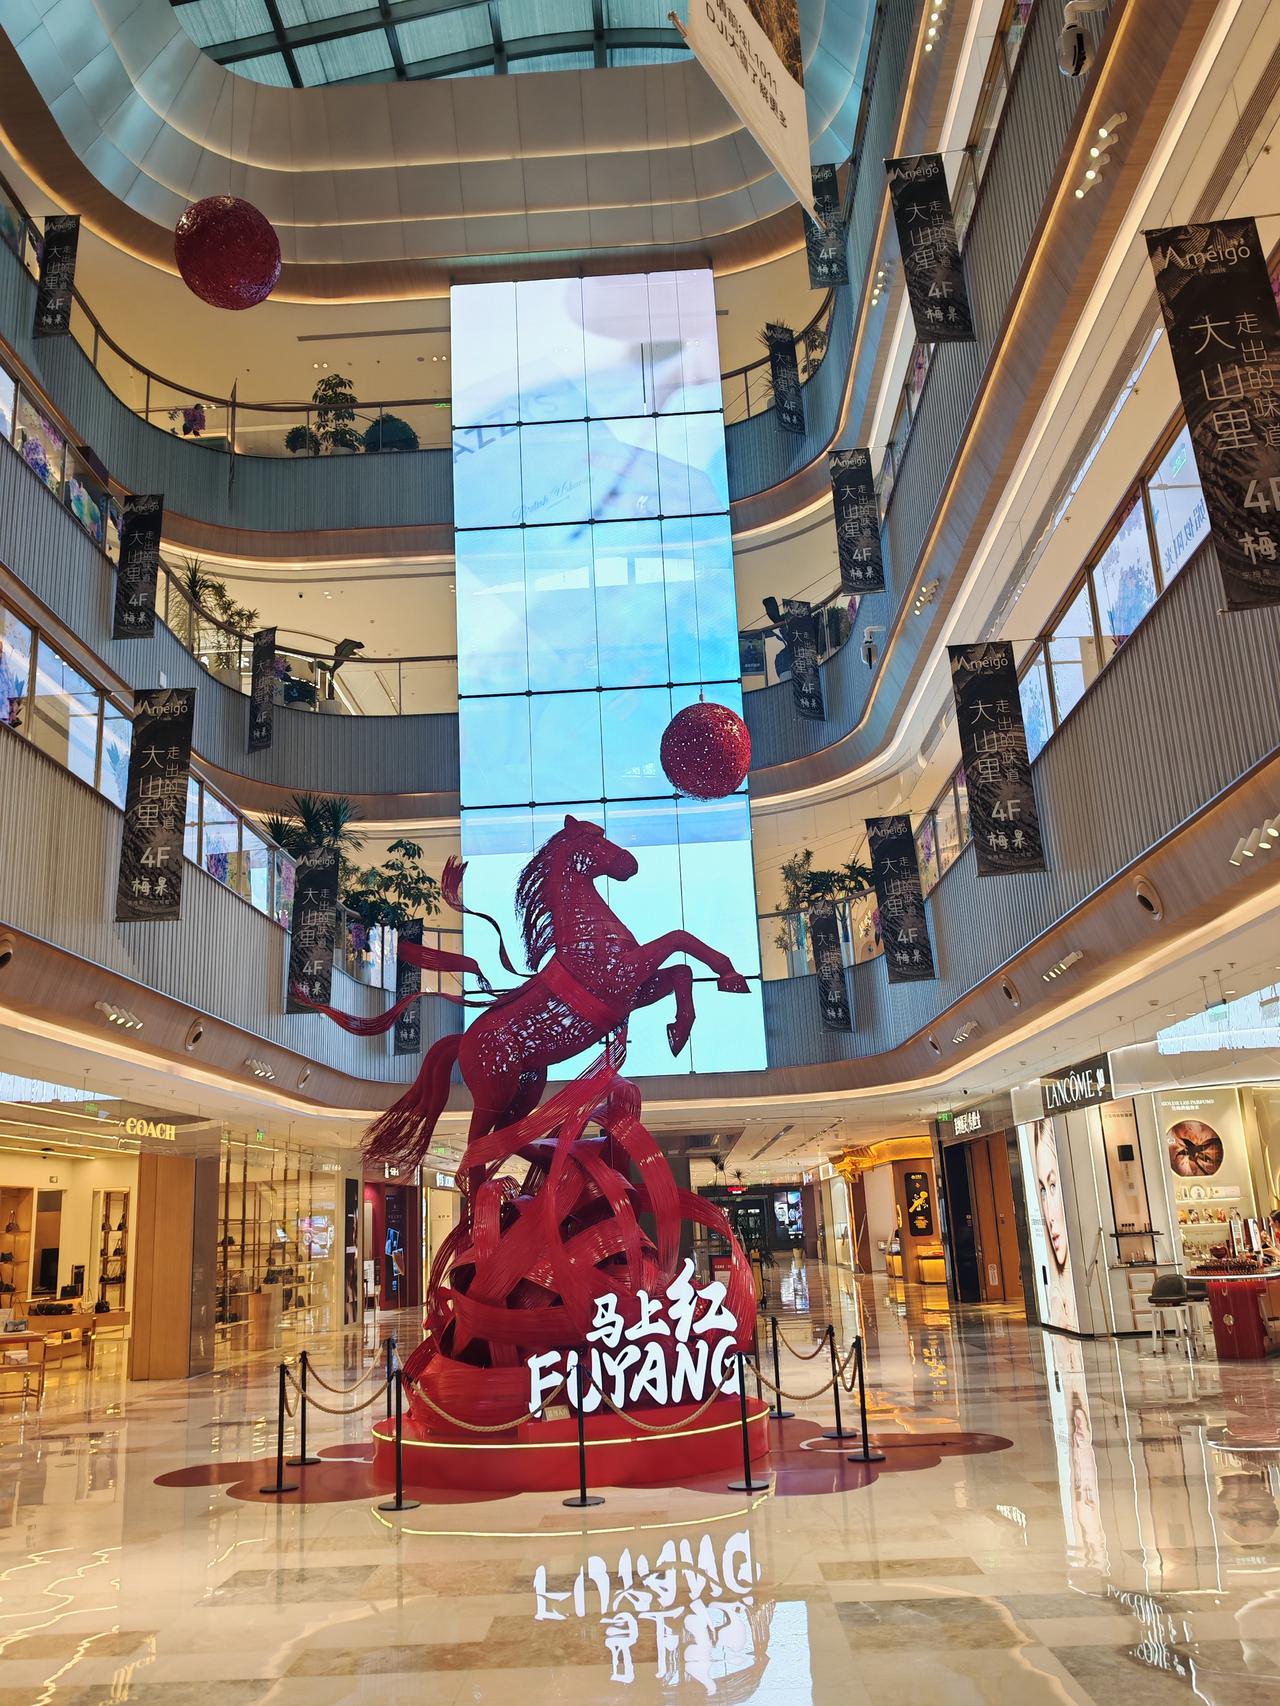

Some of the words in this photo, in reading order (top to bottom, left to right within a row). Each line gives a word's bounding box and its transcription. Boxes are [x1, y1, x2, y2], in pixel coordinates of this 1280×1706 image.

[905, 203, 937, 271] 大山里
[819, 247, 837, 260] 4F
[928, 282, 953, 299] 4F
[46, 298, 64, 310] 4F
[925, 305, 960, 323] 梅果
[1189, 315, 1258, 450] 大山里
[783, 400, 797, 411] 4F
[840, 485, 860, 538] 大山里
[852, 547, 872, 562] 4F
[128, 592, 148, 607] 4F
[802, 683, 815, 694] 4F
[969, 700, 1002, 783] 大山里
[995, 699, 1021, 783] 走出的味道
[136, 745, 165, 828] 大山里
[161, 746, 180, 831] 走出的味道
[991, 800, 1021, 822] 4F
[987, 830, 1028, 851] 梅果
[140, 847, 171, 868] 4F
[131, 876, 169, 898] 梅果
[881, 858, 904, 918] 大山里
[898, 928, 918, 944] 4F
[302, 960, 324, 976] 4F
[828, 990, 841, 1003] 4F
[402, 1010, 416, 1023] 4F
[1045, 1070, 1095, 1109] LANCÔME
[126, 1117, 176, 1141] COACH
[586, 1258, 738, 1348] 马上红
[528, 1336, 746, 1418] FUYANG
